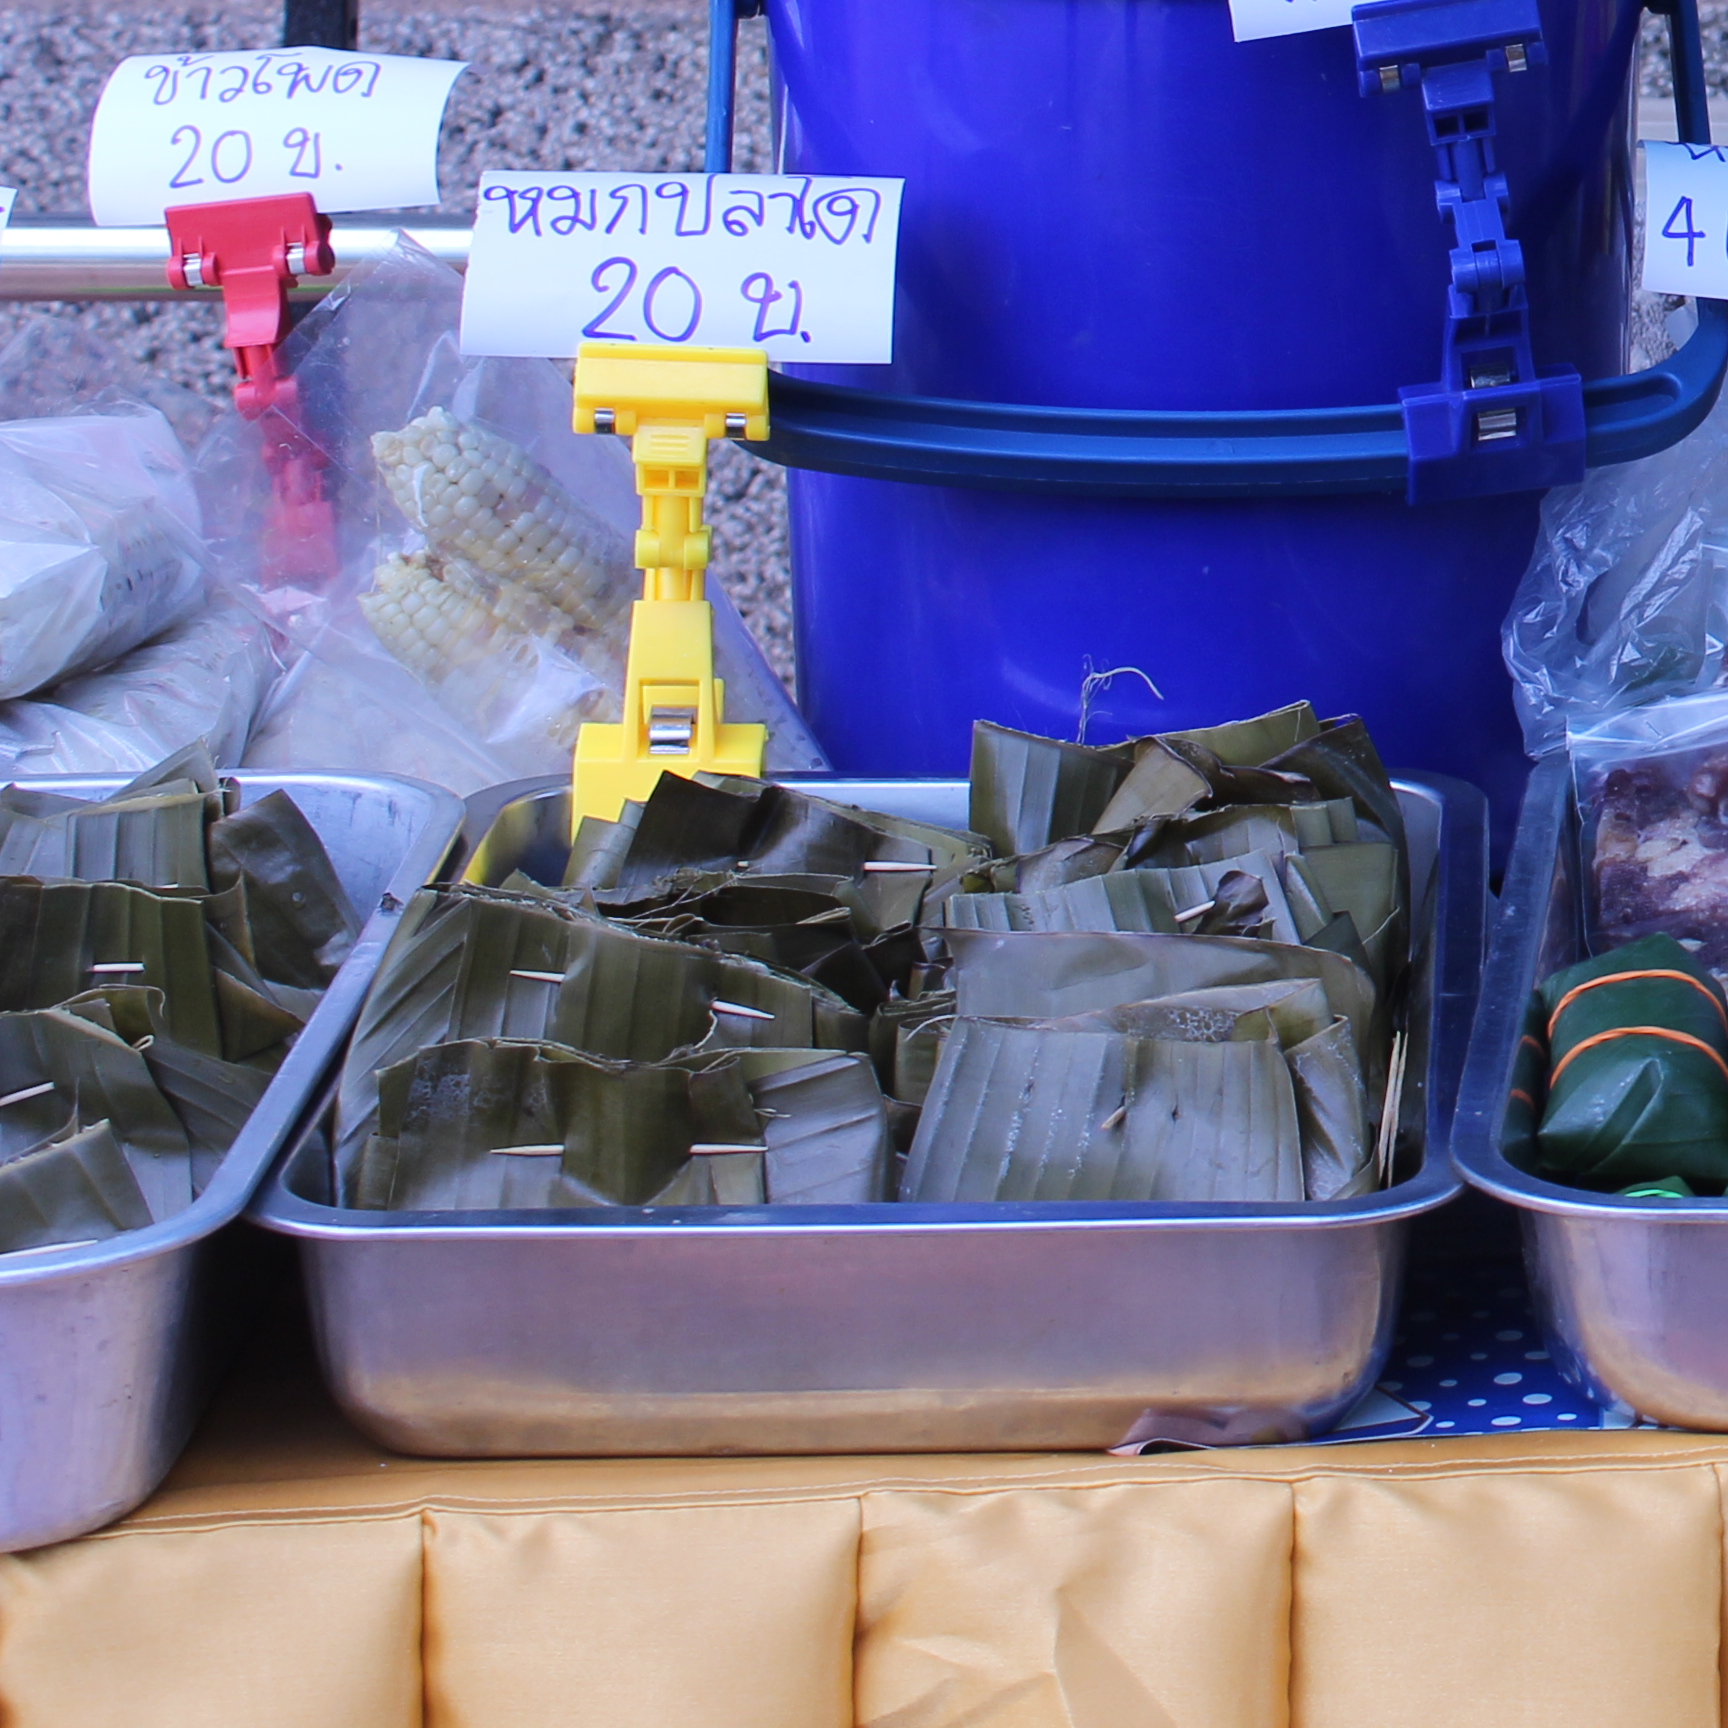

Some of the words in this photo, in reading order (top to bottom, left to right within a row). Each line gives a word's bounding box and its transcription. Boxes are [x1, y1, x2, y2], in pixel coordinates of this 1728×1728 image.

[143, 51, 383, 106] ข้าวโพด
[168, 123, 254, 191] 20
[1661, 194, 1708, 268] 4
[579, 255, 704, 343] 20
